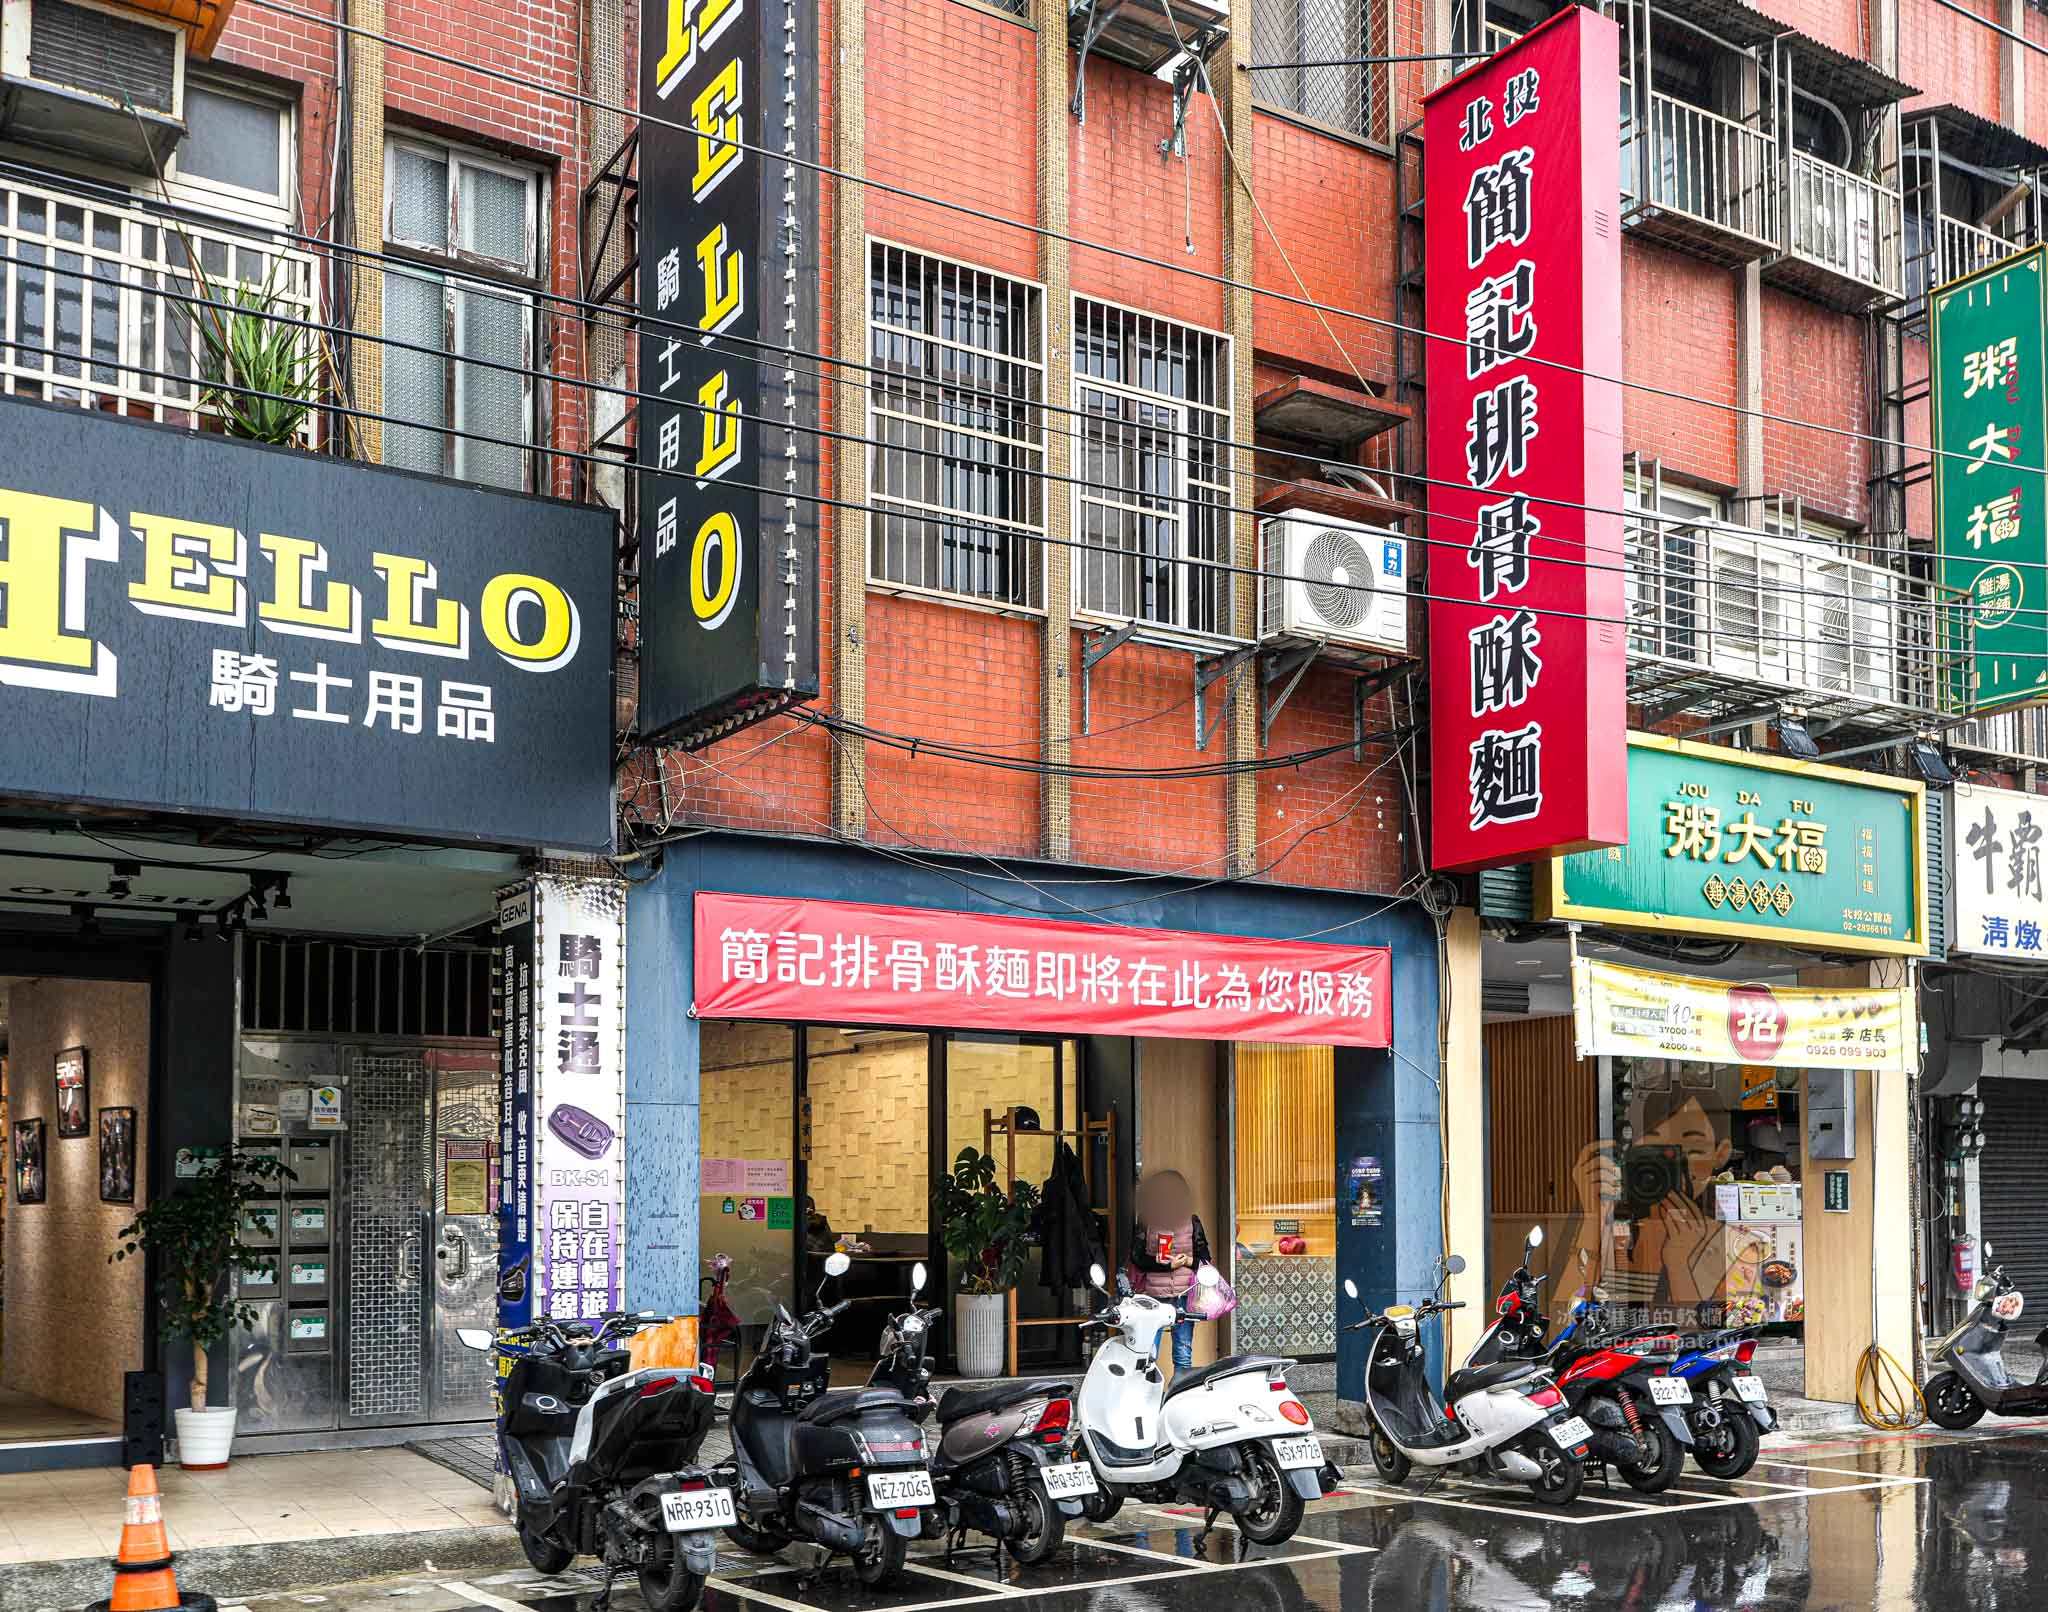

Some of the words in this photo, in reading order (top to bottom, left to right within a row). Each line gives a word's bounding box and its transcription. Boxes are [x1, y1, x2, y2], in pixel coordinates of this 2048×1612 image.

[1458, 65, 1540, 152] 北投
[656, 246, 681, 560] 騎士用品
[1962, 336, 2020, 550] 粥大福
[1463, 145, 1541, 833] 簡記排骨酥麵
[208, 647, 497, 744] 騎士用品
[1664, 801, 1828, 874] 粥大福
[1679, 783, 1710, 799] JOU
[1737, 790, 1762, 806] DA
[1792, 799, 1816, 815] FU
[501, 901, 528, 923] GENA
[558, 933, 602, 1075] 騎士通
[718, 926, 1374, 1020] 簡記排骨酥麵即將在此為您服務
[1737, 999, 1780, 1044] 招
[1806, 1045, 1836, 1056] 0926
[551, 1169, 609, 1187] BK-S1
[550, 1200, 580, 1319] 保持連線
[665, 1497, 731, 1522] NRR-9310
[871, 1479, 932, 1501] NEZ-2065
